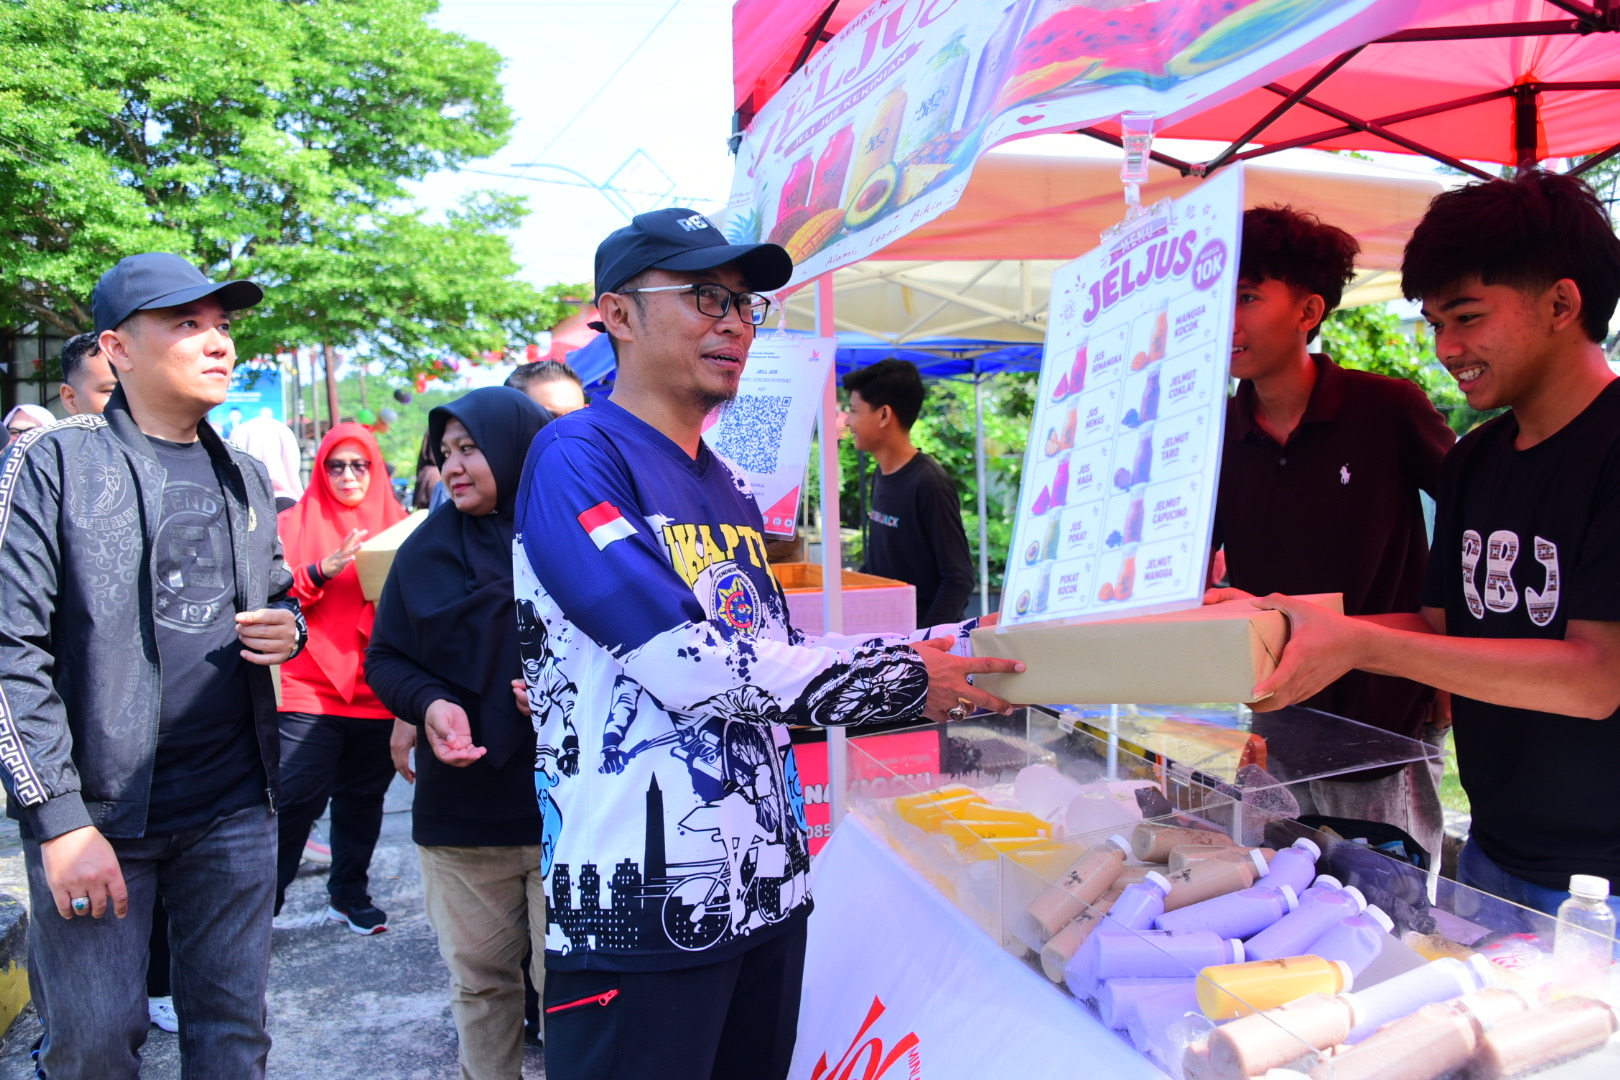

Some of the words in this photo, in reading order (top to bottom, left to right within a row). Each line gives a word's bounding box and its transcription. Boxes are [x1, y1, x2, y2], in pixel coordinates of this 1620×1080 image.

[840, 7, 875, 43] SEHAT,
[794, 126, 816, 147] JELI
[820, 108, 841, 130] JUS
[844, 52, 908, 108] KEKINIAN
[869, 225, 901, 247] Lezat,
[910, 200, 943, 223] Bikin
[1083, 230, 1197, 323] JELJUS
[1196, 253, 1225, 285] 10K
[1175, 304, 1206, 325] MANGGA
[1173, 320, 1199, 338] KOCOK
[1091, 353, 1122, 374] SEMANGKA
[1092, 350, 1105, 364] JUS
[1169, 368, 1197, 388] JELMUT
[1168, 382, 1196, 399] COKLAT
[1086, 407, 1099, 419] JUS
[1085, 415, 1105, 430] NENAS
[1162, 432, 1190, 449] JELMUT
[1161, 447, 1180, 461] TARO
[1078, 463, 1090, 476] JUS
[1077, 474, 1093, 486] NAGA
[1153, 496, 1182, 513] JELMUT
[1152, 507, 1187, 525] CAPUCINO
[1070, 521, 1082, 532] JUS
[1068, 531, 1087, 544] POKAT
[1145, 556, 1173, 571] JELMUT
[1059, 572, 1080, 585] POKAT
[1144, 568, 1173, 582] MANGGA
[1058, 584, 1078, 596] KOCOK
